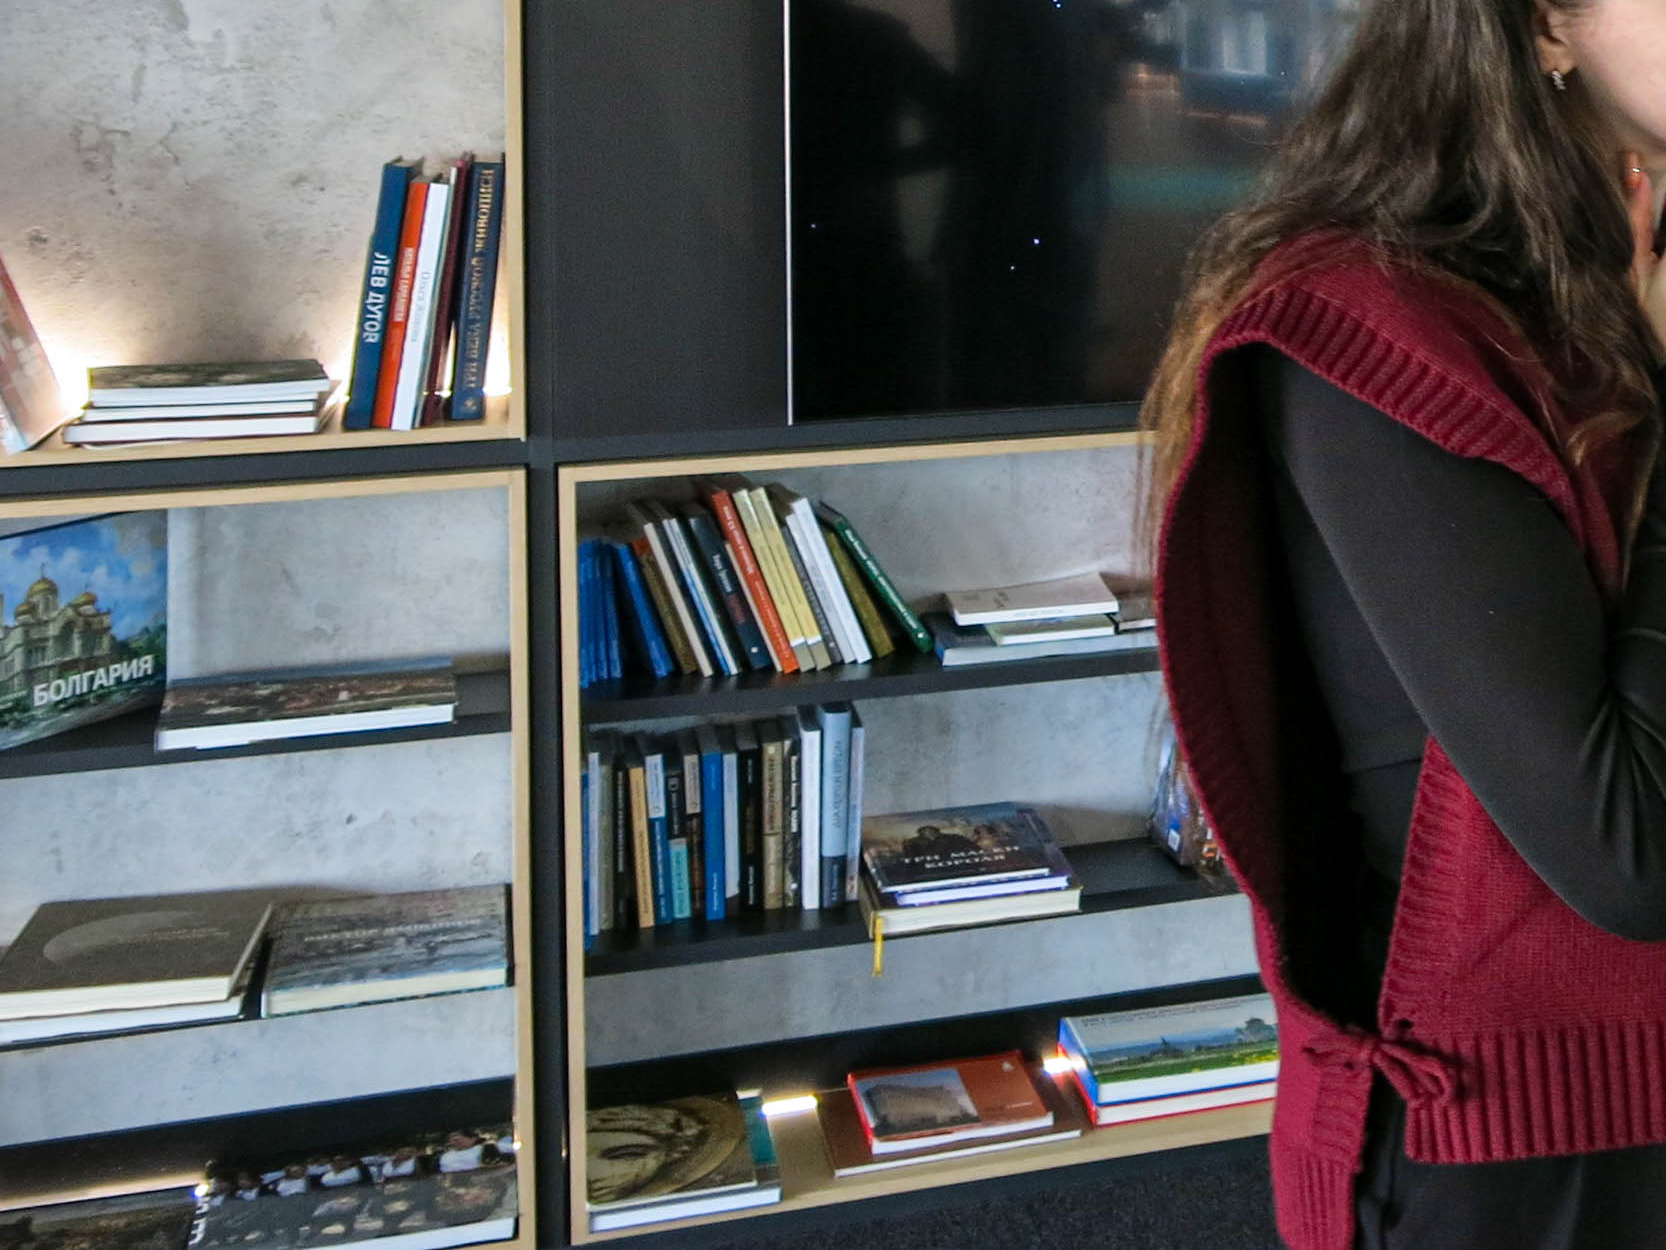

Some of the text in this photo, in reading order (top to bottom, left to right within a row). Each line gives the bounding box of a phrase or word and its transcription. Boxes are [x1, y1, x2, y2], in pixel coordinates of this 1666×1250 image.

[474, 168, 494, 253] ЖИВОПИСИ
[370, 252, 391, 287] ЛЕВ
[32, 654, 155, 707] БОЛГАРИЯ
[903, 854, 942, 864] ТРИ
